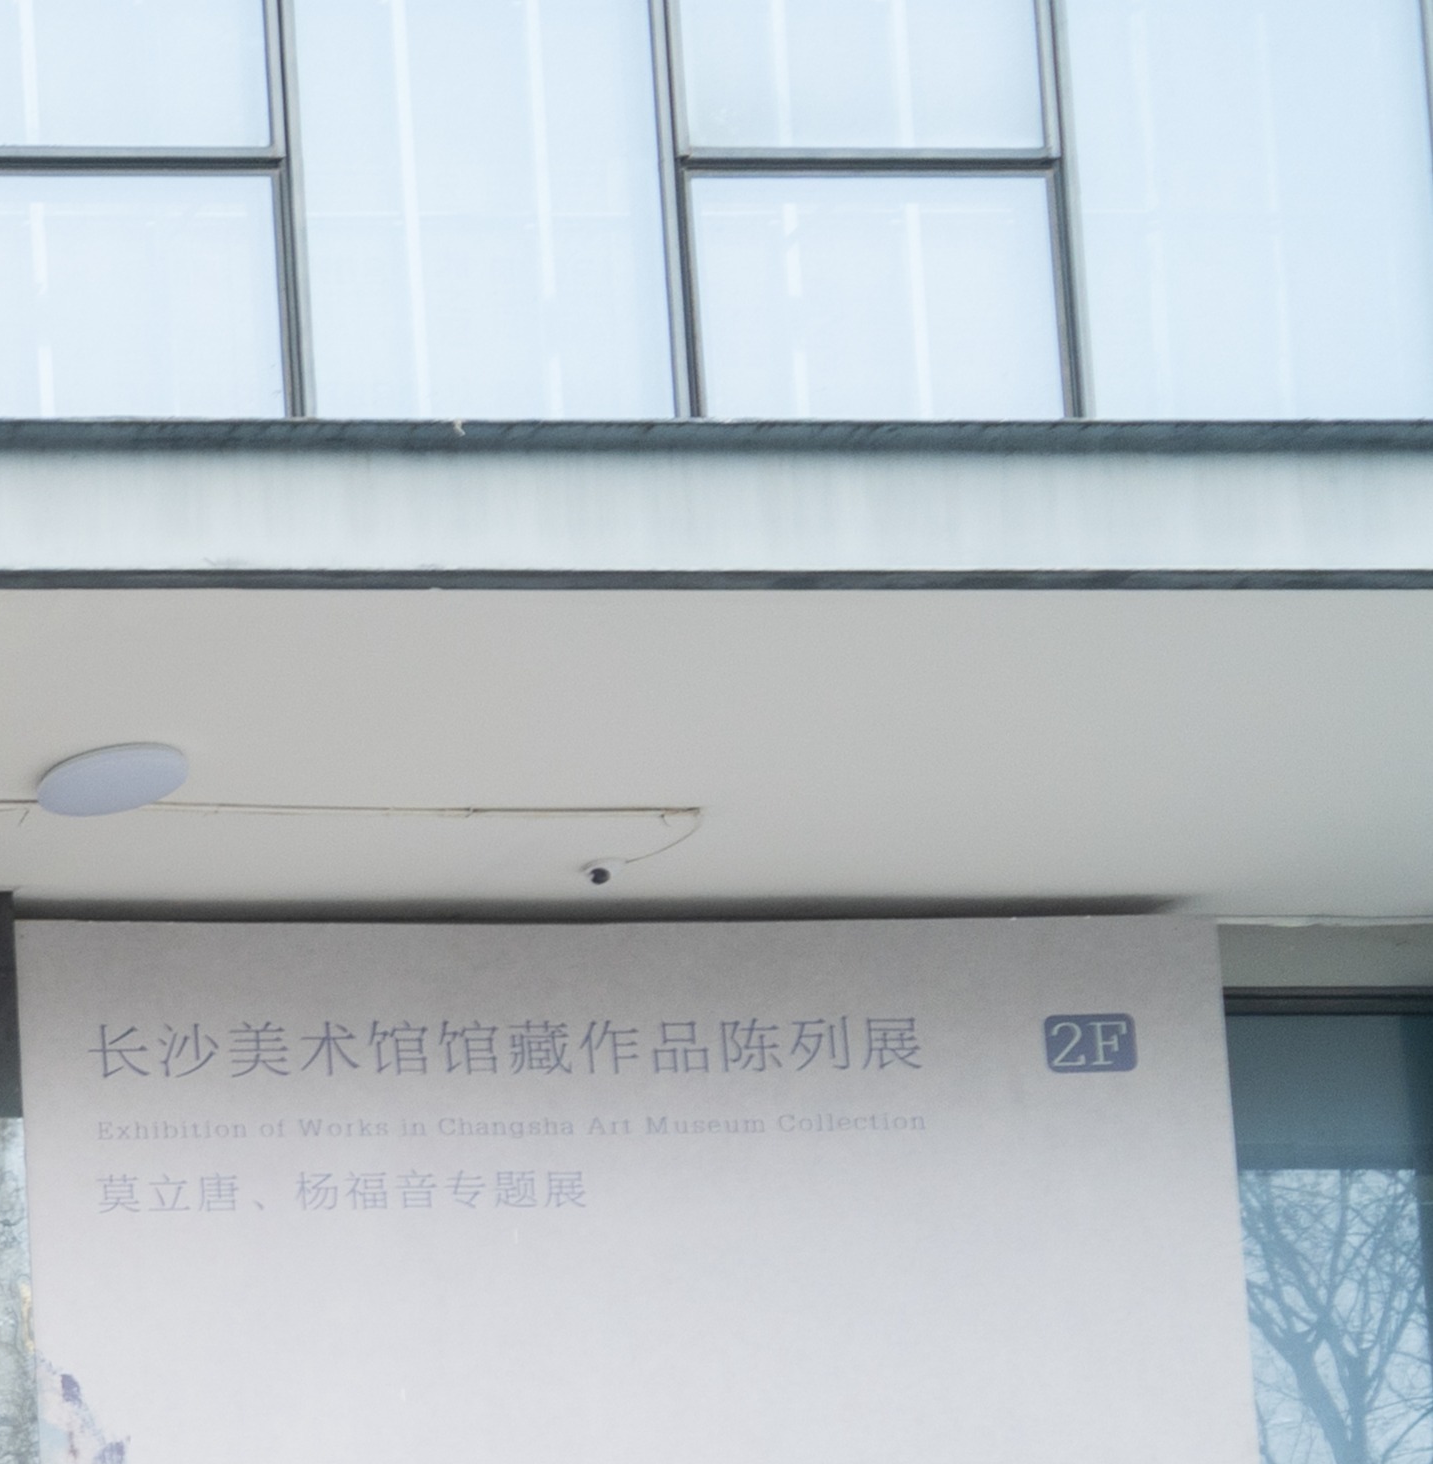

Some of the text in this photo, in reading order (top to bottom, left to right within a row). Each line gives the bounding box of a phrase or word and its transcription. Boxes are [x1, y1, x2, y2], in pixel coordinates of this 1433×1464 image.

[88, 1016, 922, 1079] 长沙美术馆馆藏作品陈列展
[1051, 1020, 1128, 1067] 2F
[97, 1111, 927, 1141] Exhibition of Works in Changsha Art Museum Collection
[97, 1169, 587, 1214] 莫立唐、杨福音专题展
